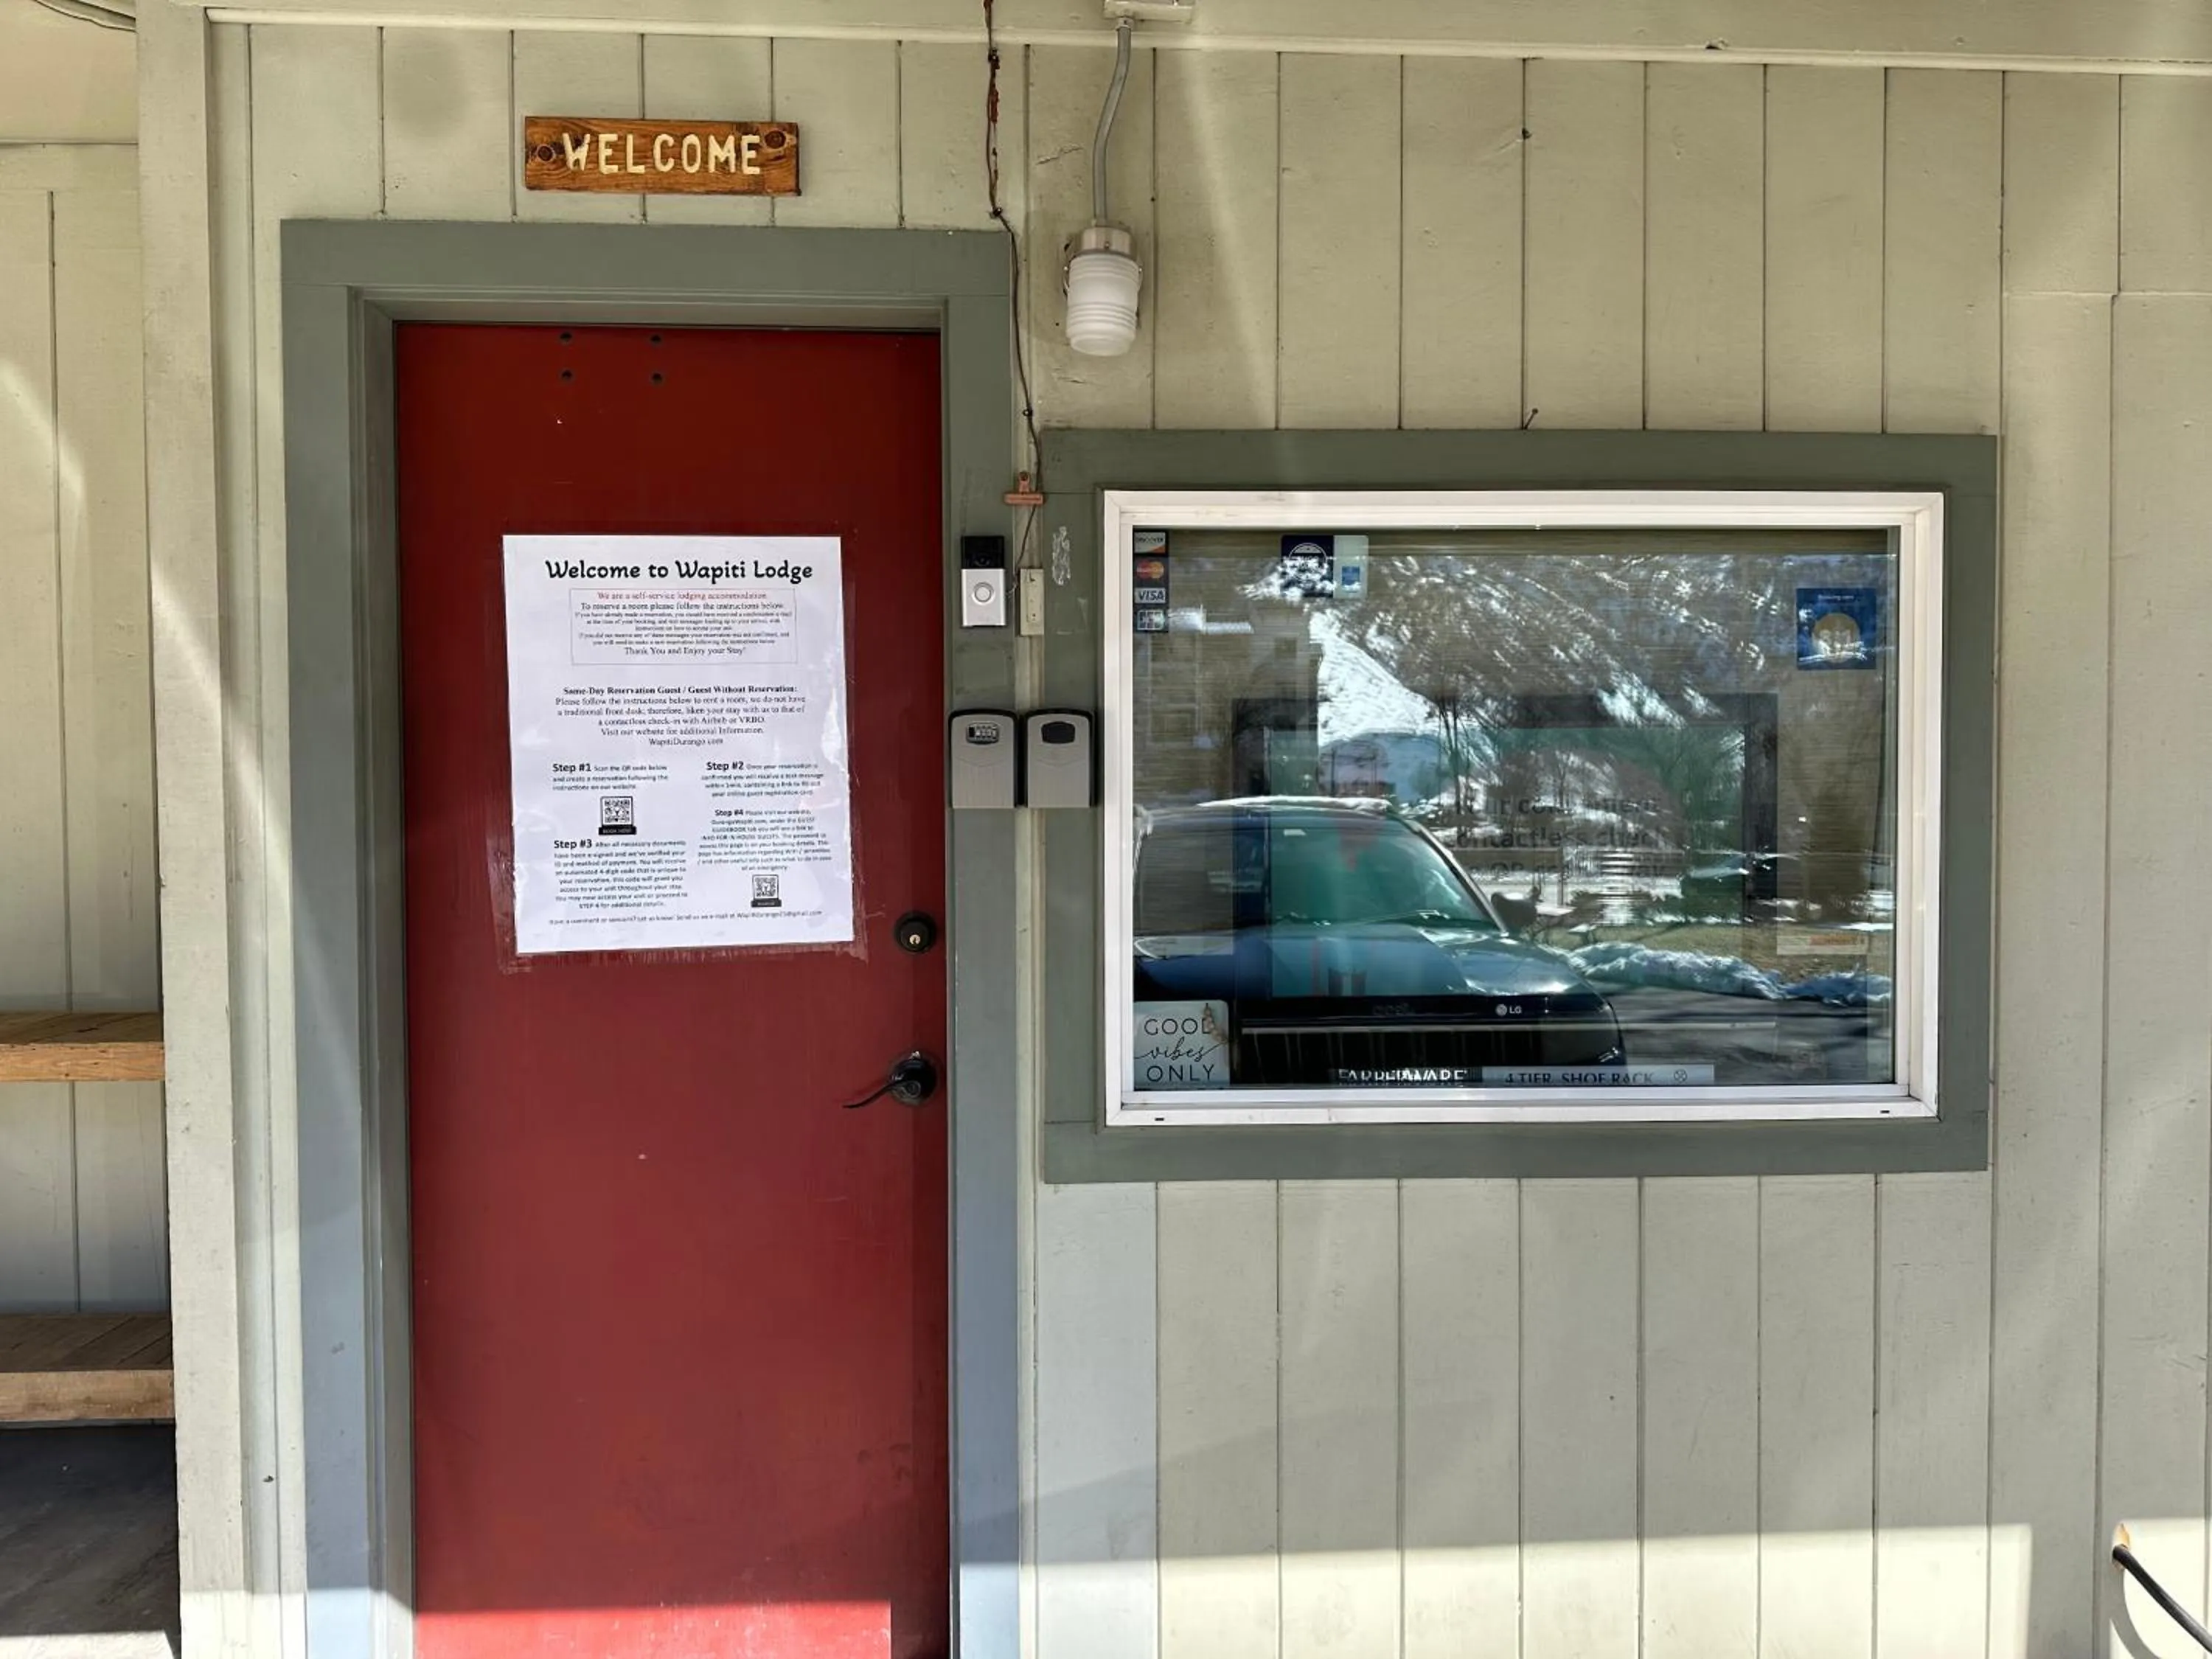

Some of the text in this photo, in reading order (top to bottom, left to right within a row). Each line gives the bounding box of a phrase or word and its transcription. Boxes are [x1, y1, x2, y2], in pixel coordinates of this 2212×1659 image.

[563, 133, 760, 175] WELCOME
[545, 560, 813, 585] Welcome to Wapiti Lodge
[1138, 591, 1164, 601] VISA
[684, 647, 705, 656] Enjoy
[563, 687, 604, 697] Same-Day
[552, 763, 577, 774] Step
[579, 763, 592, 772] #1
[706, 762, 729, 771] Step
[732, 761, 744, 770] #2
[554, 839, 577, 849] Step
[580, 838, 593, 848] #3
[1509, 1005, 1522, 1015] LG
[1135, 1036, 1224, 1062] vibes
[1147, 1065, 1214, 1082] ONLY
[1561, 1072, 1606, 1084] SHOE
[1611, 1072, 1654, 1084] RACK
